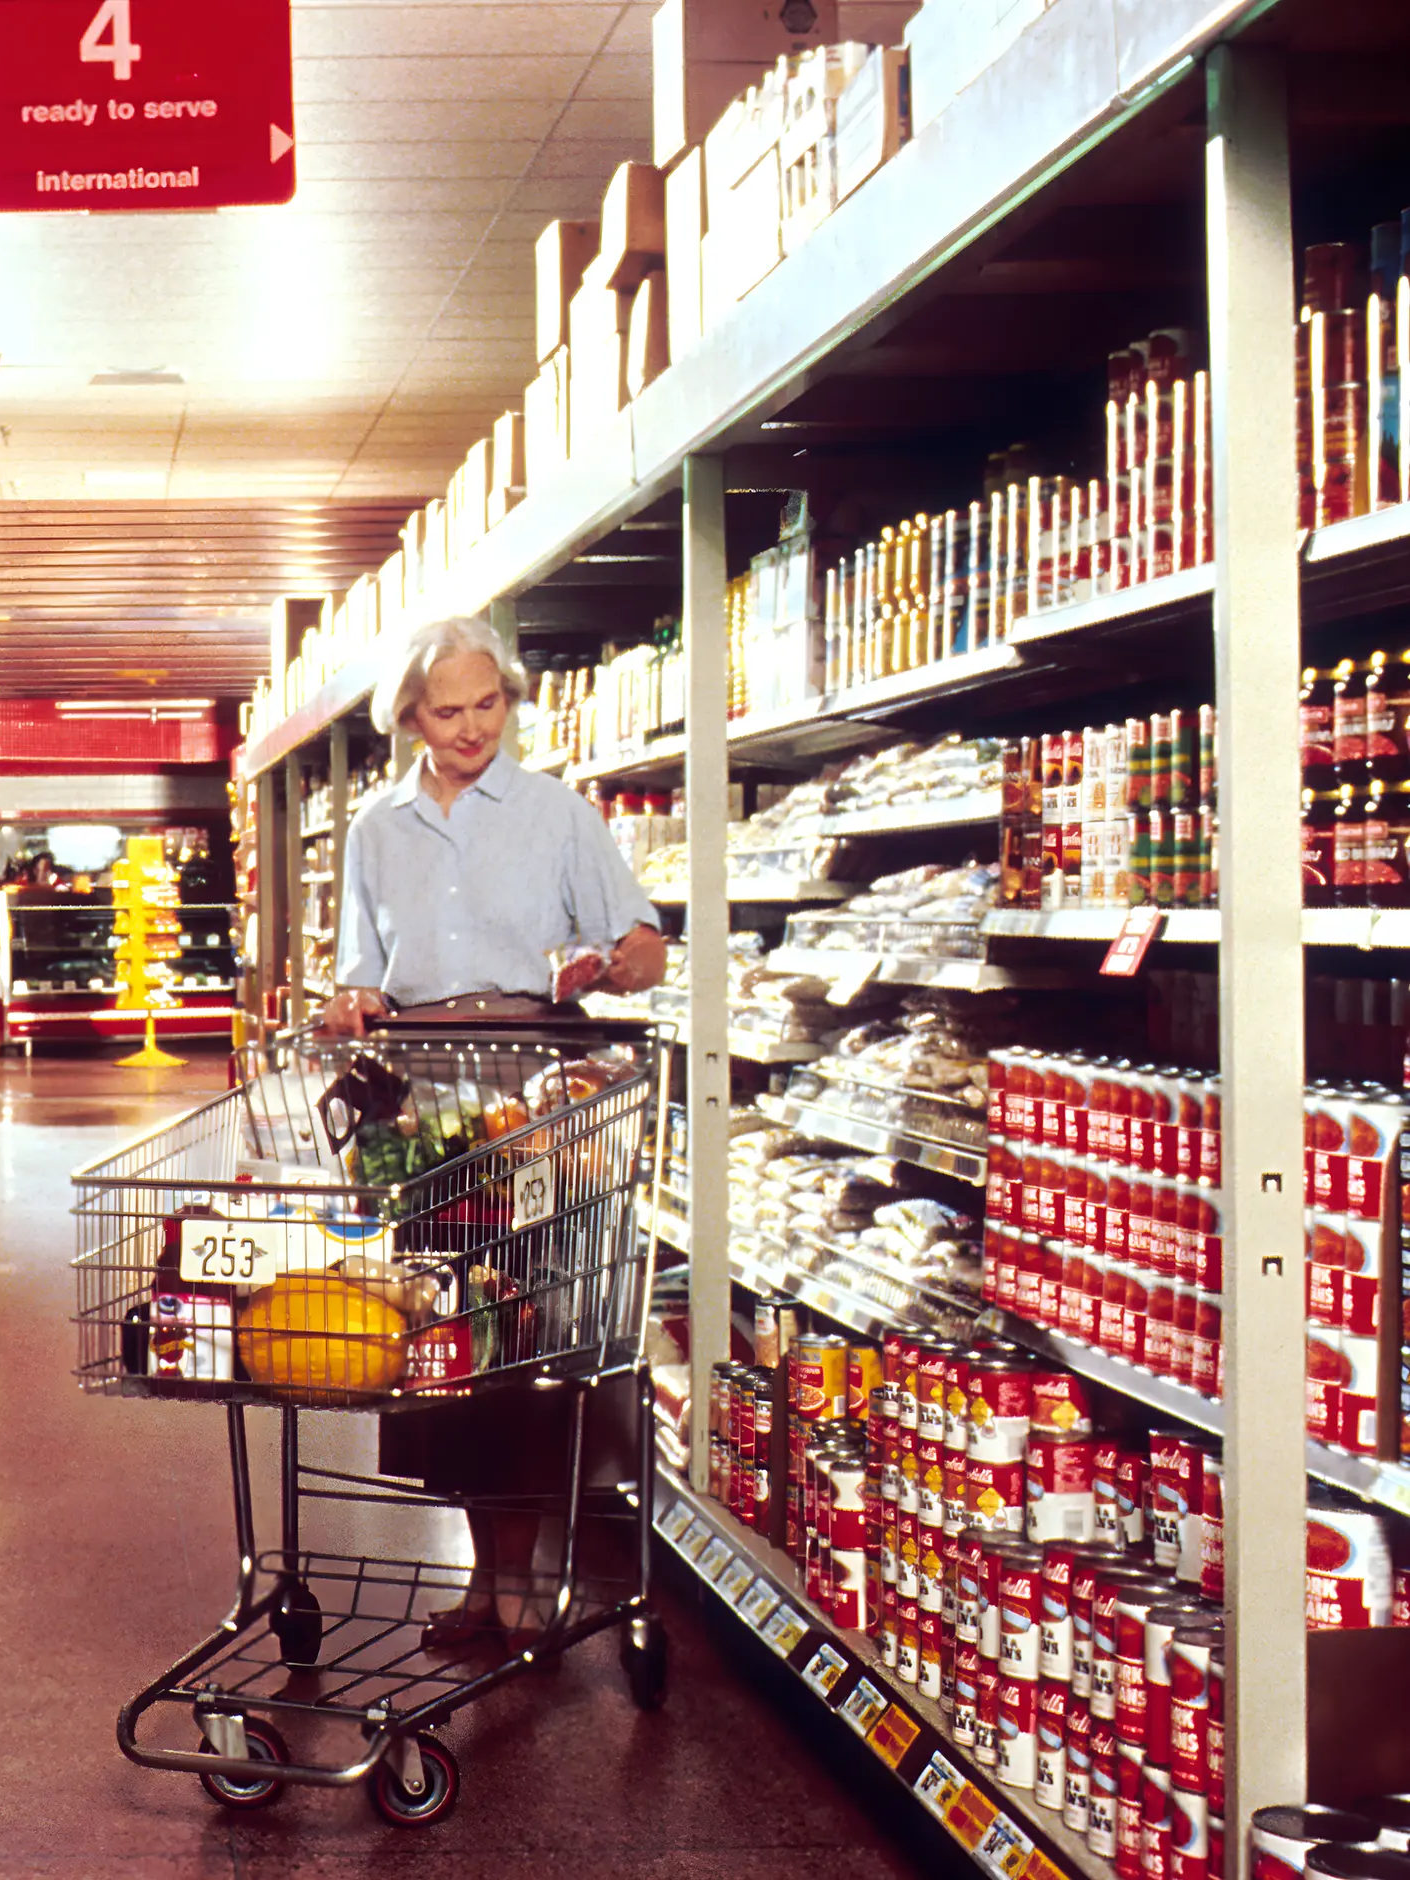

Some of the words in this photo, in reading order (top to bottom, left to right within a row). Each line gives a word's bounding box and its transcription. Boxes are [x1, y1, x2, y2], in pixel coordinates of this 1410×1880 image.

[79, 0, 141, 80] 4
[21, 99, 97, 126] ready
[107, 99, 135, 121] to
[144, 99, 218, 119] serve
[36, 166, 200, 192] international
[201, 1236, 257, 1279] 253
